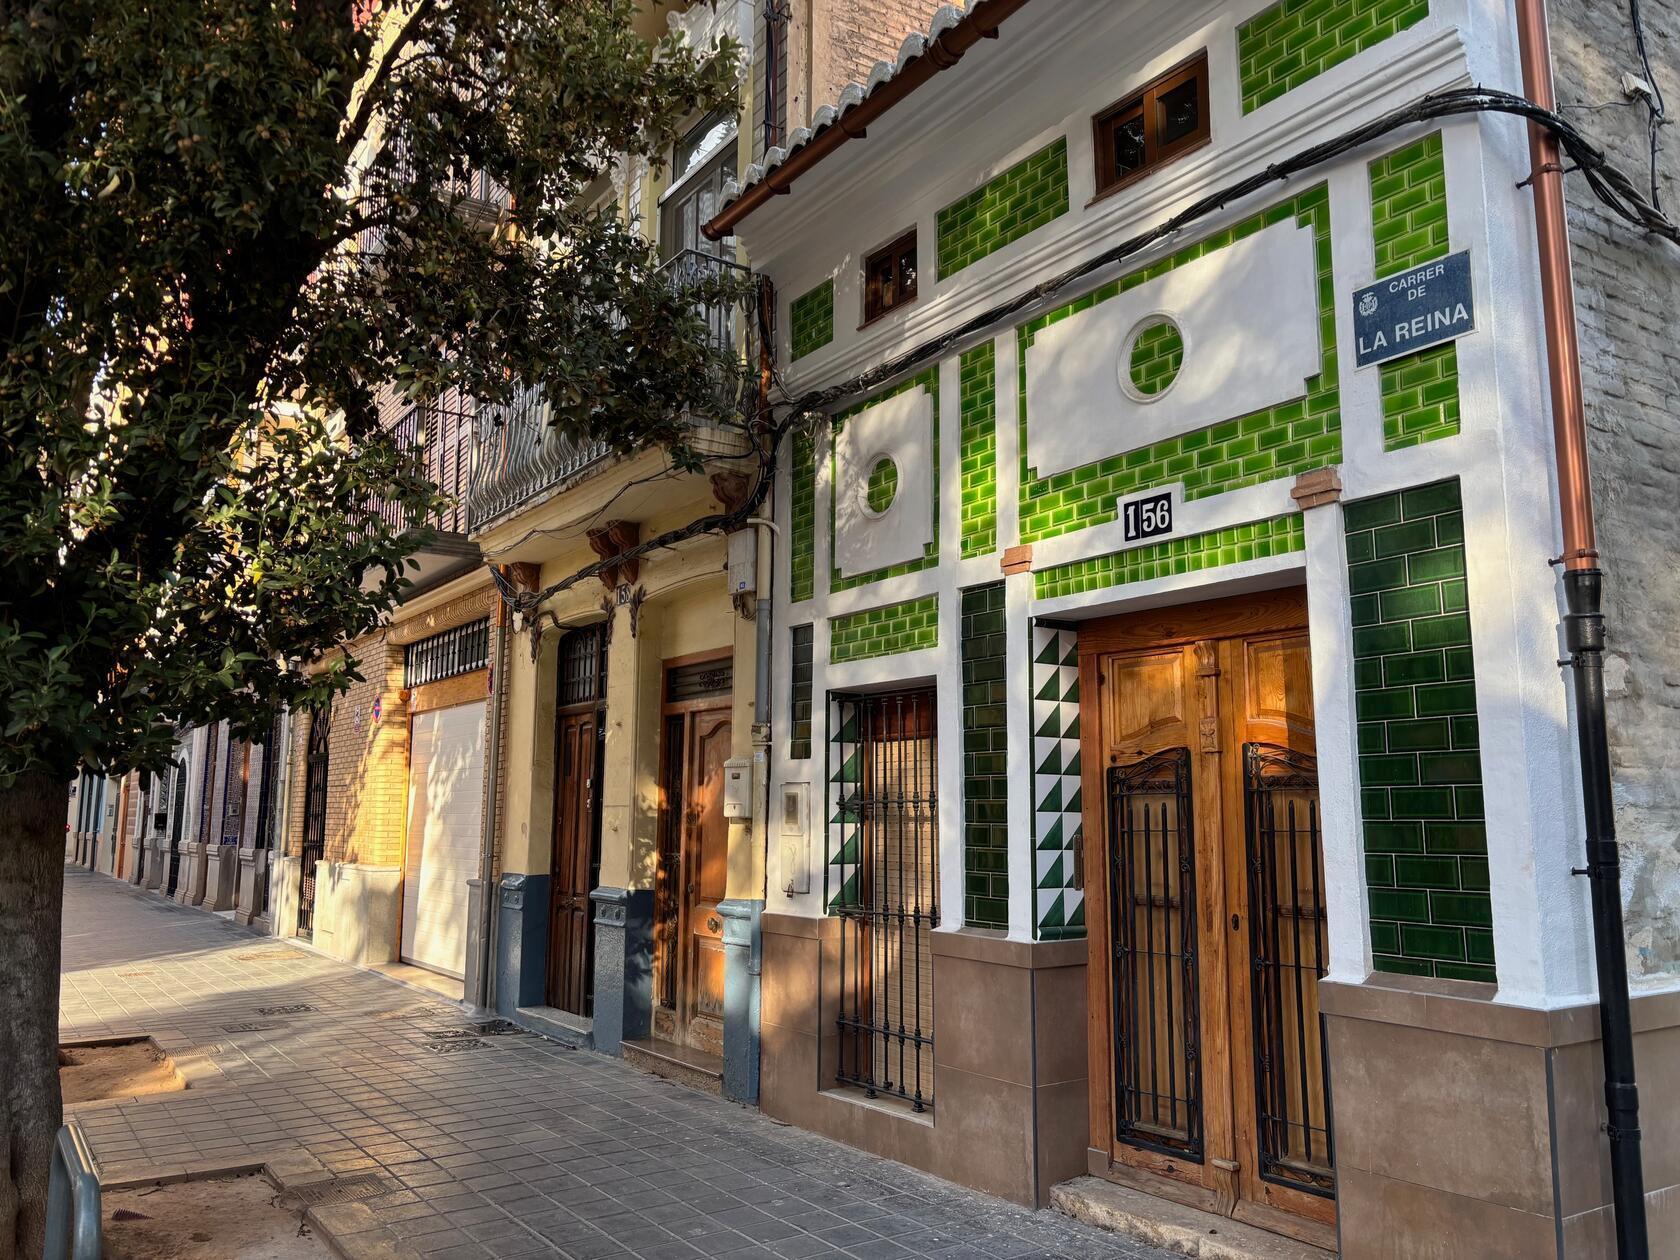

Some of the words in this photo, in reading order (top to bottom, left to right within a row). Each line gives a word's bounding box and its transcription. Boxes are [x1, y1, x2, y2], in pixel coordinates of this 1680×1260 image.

[1388, 264, 1445, 293] CARRER
[1407, 285, 1427, 301] DE
[1359, 330, 1388, 355] LA
[1395, 302, 1469, 342] REINA
[1126, 499, 1170, 538] 156
